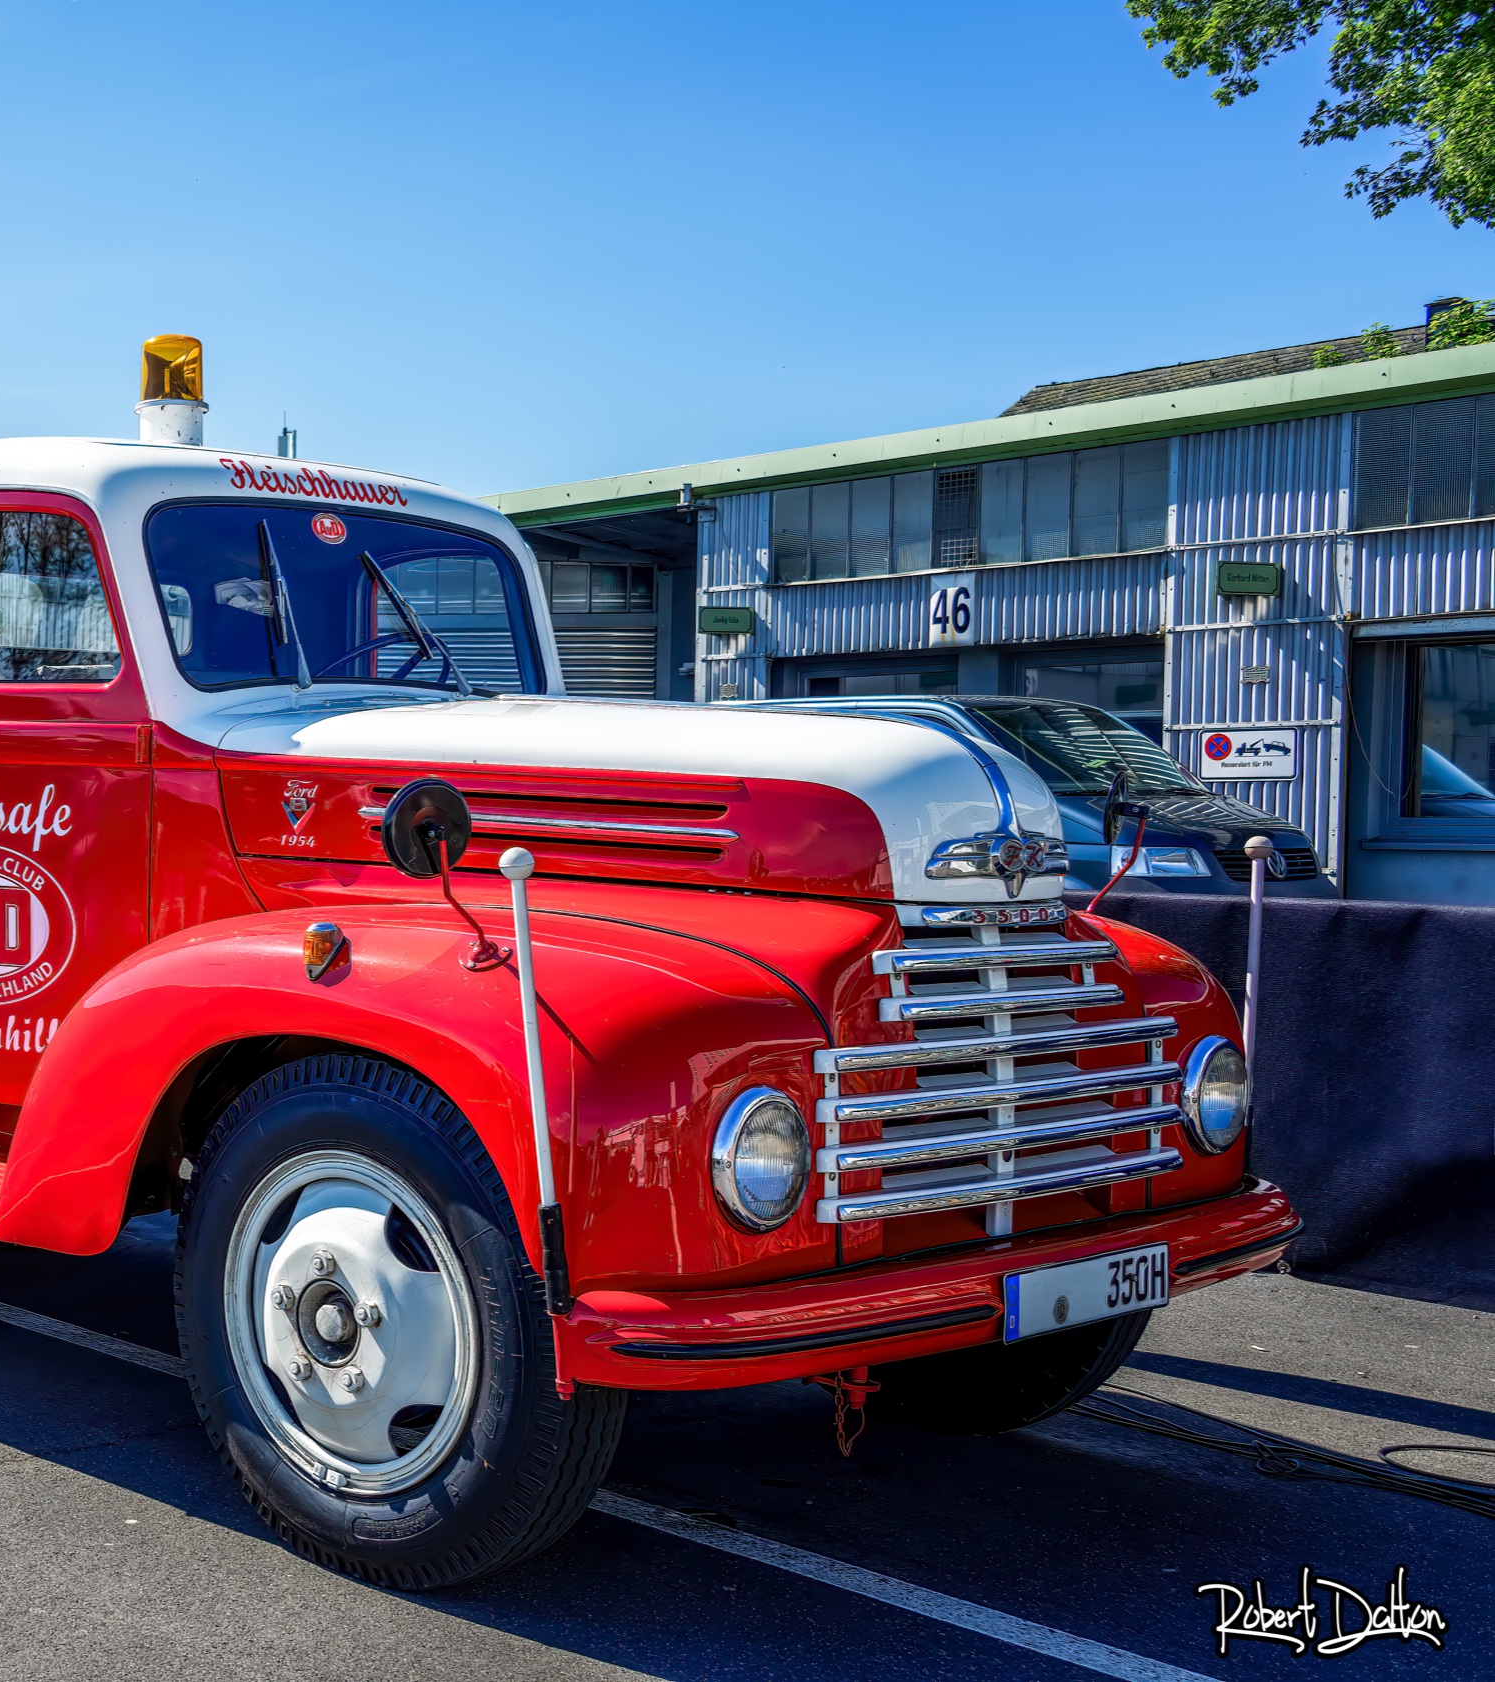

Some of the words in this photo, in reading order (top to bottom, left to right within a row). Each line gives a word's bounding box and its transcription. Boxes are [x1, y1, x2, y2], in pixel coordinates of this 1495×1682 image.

[219, 458, 408, 507] Fleischhauer
[932, 586, 971, 635] 46
[283, 779, 319, 798] Ford
[280, 834, 316, 848] 1954
[973, 907, 1049, 924] 3500
[1106, 1251, 1165, 1309] 350H
